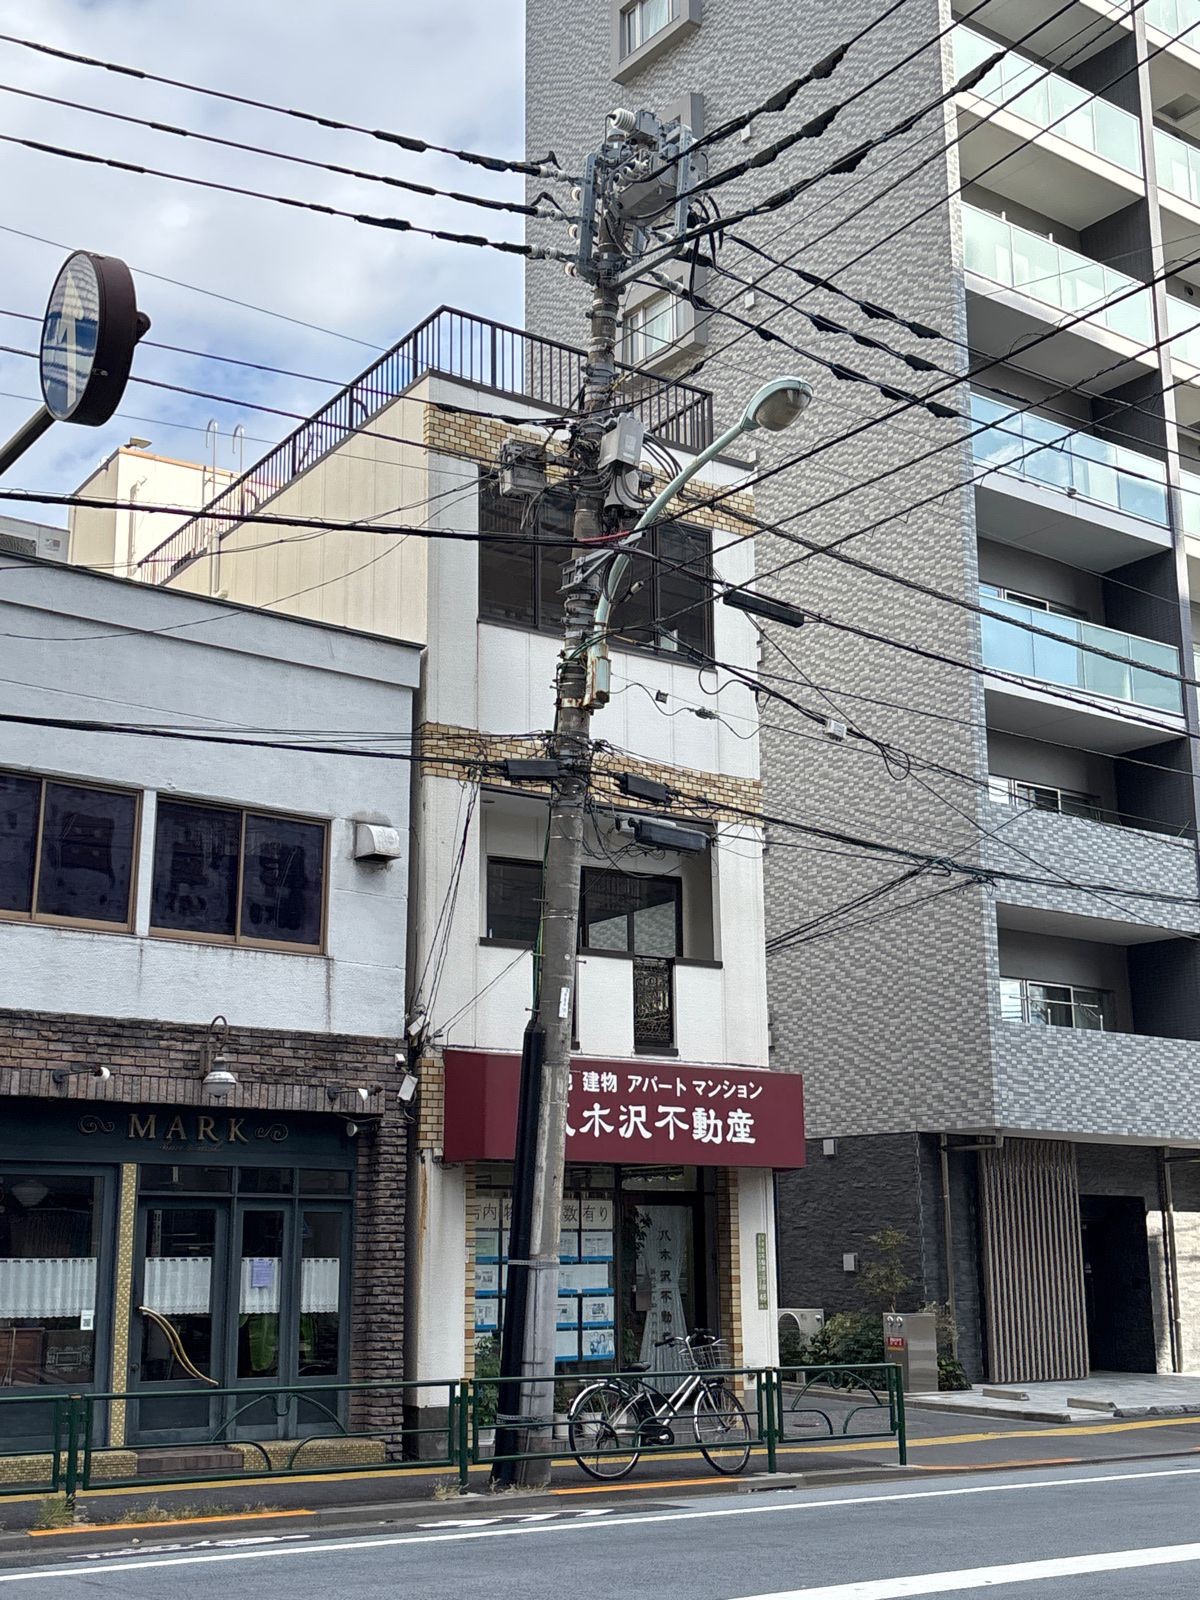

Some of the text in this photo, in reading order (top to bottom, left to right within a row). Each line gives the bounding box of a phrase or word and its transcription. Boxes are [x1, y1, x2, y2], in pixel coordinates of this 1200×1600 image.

[582, 1071, 618, 1093] 建物
[627, 1074, 687, 1097] アパート
[692, 1080, 763, 1100] マンション
[128, 1113, 249, 1144] MARK
